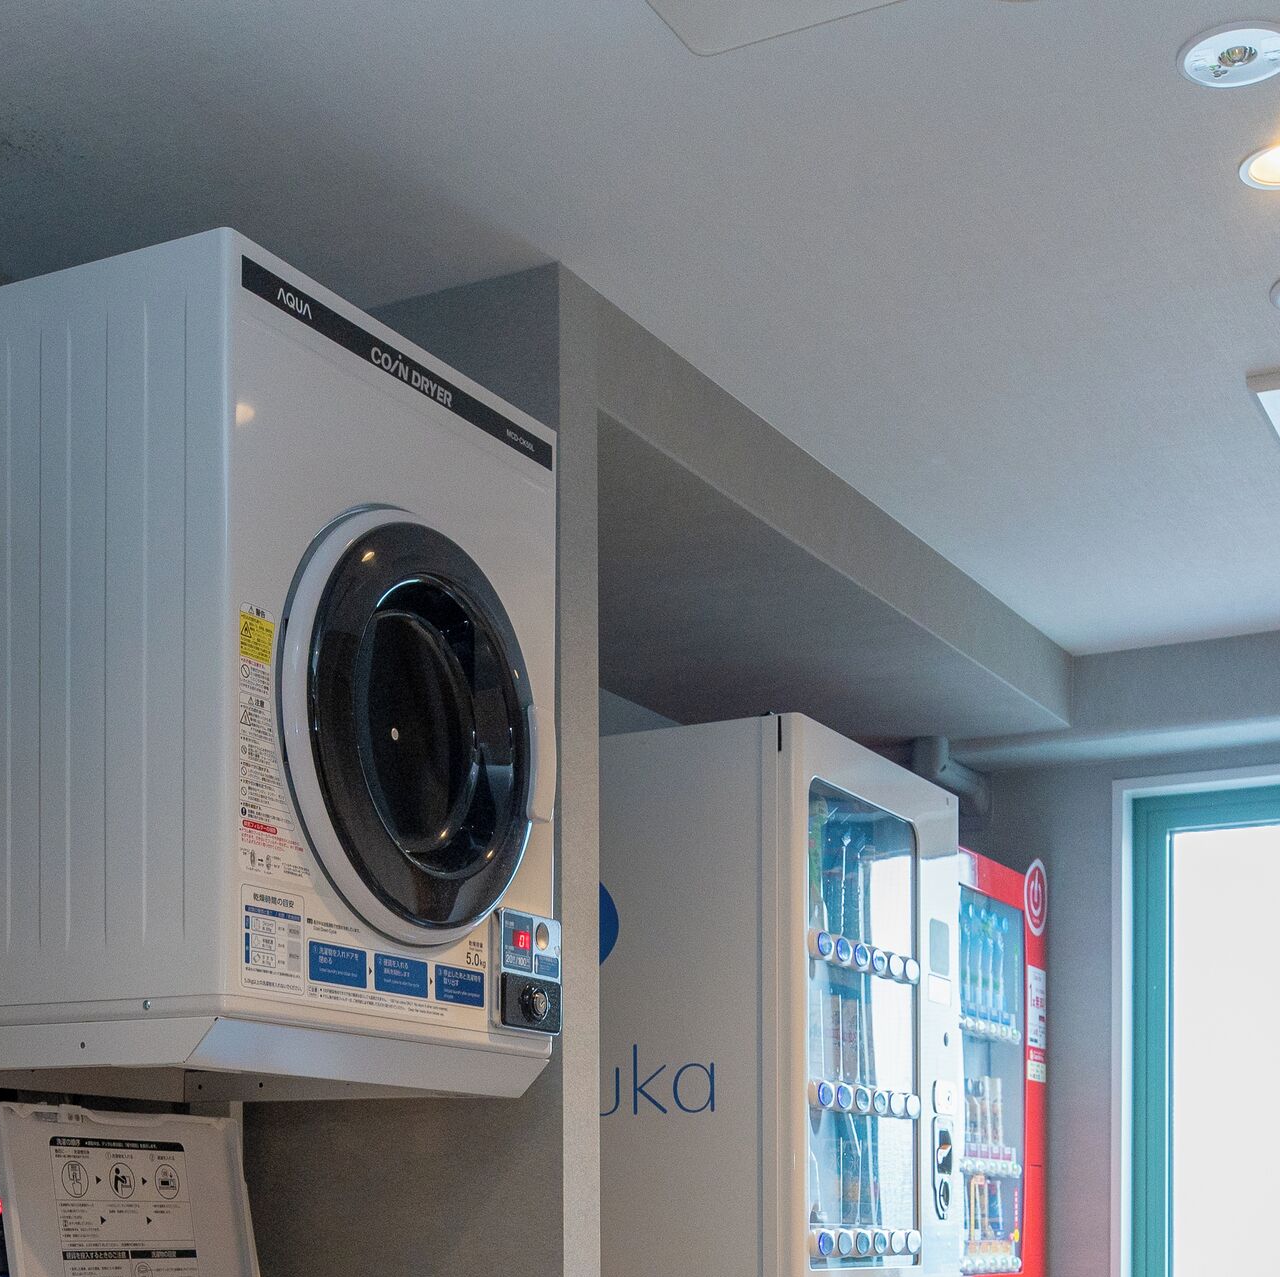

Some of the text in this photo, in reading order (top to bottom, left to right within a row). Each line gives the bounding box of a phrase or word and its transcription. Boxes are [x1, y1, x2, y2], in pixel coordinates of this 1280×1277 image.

[277, 287, 312, 320] AQUA
[370, 346, 452, 409] COIN DRYER
